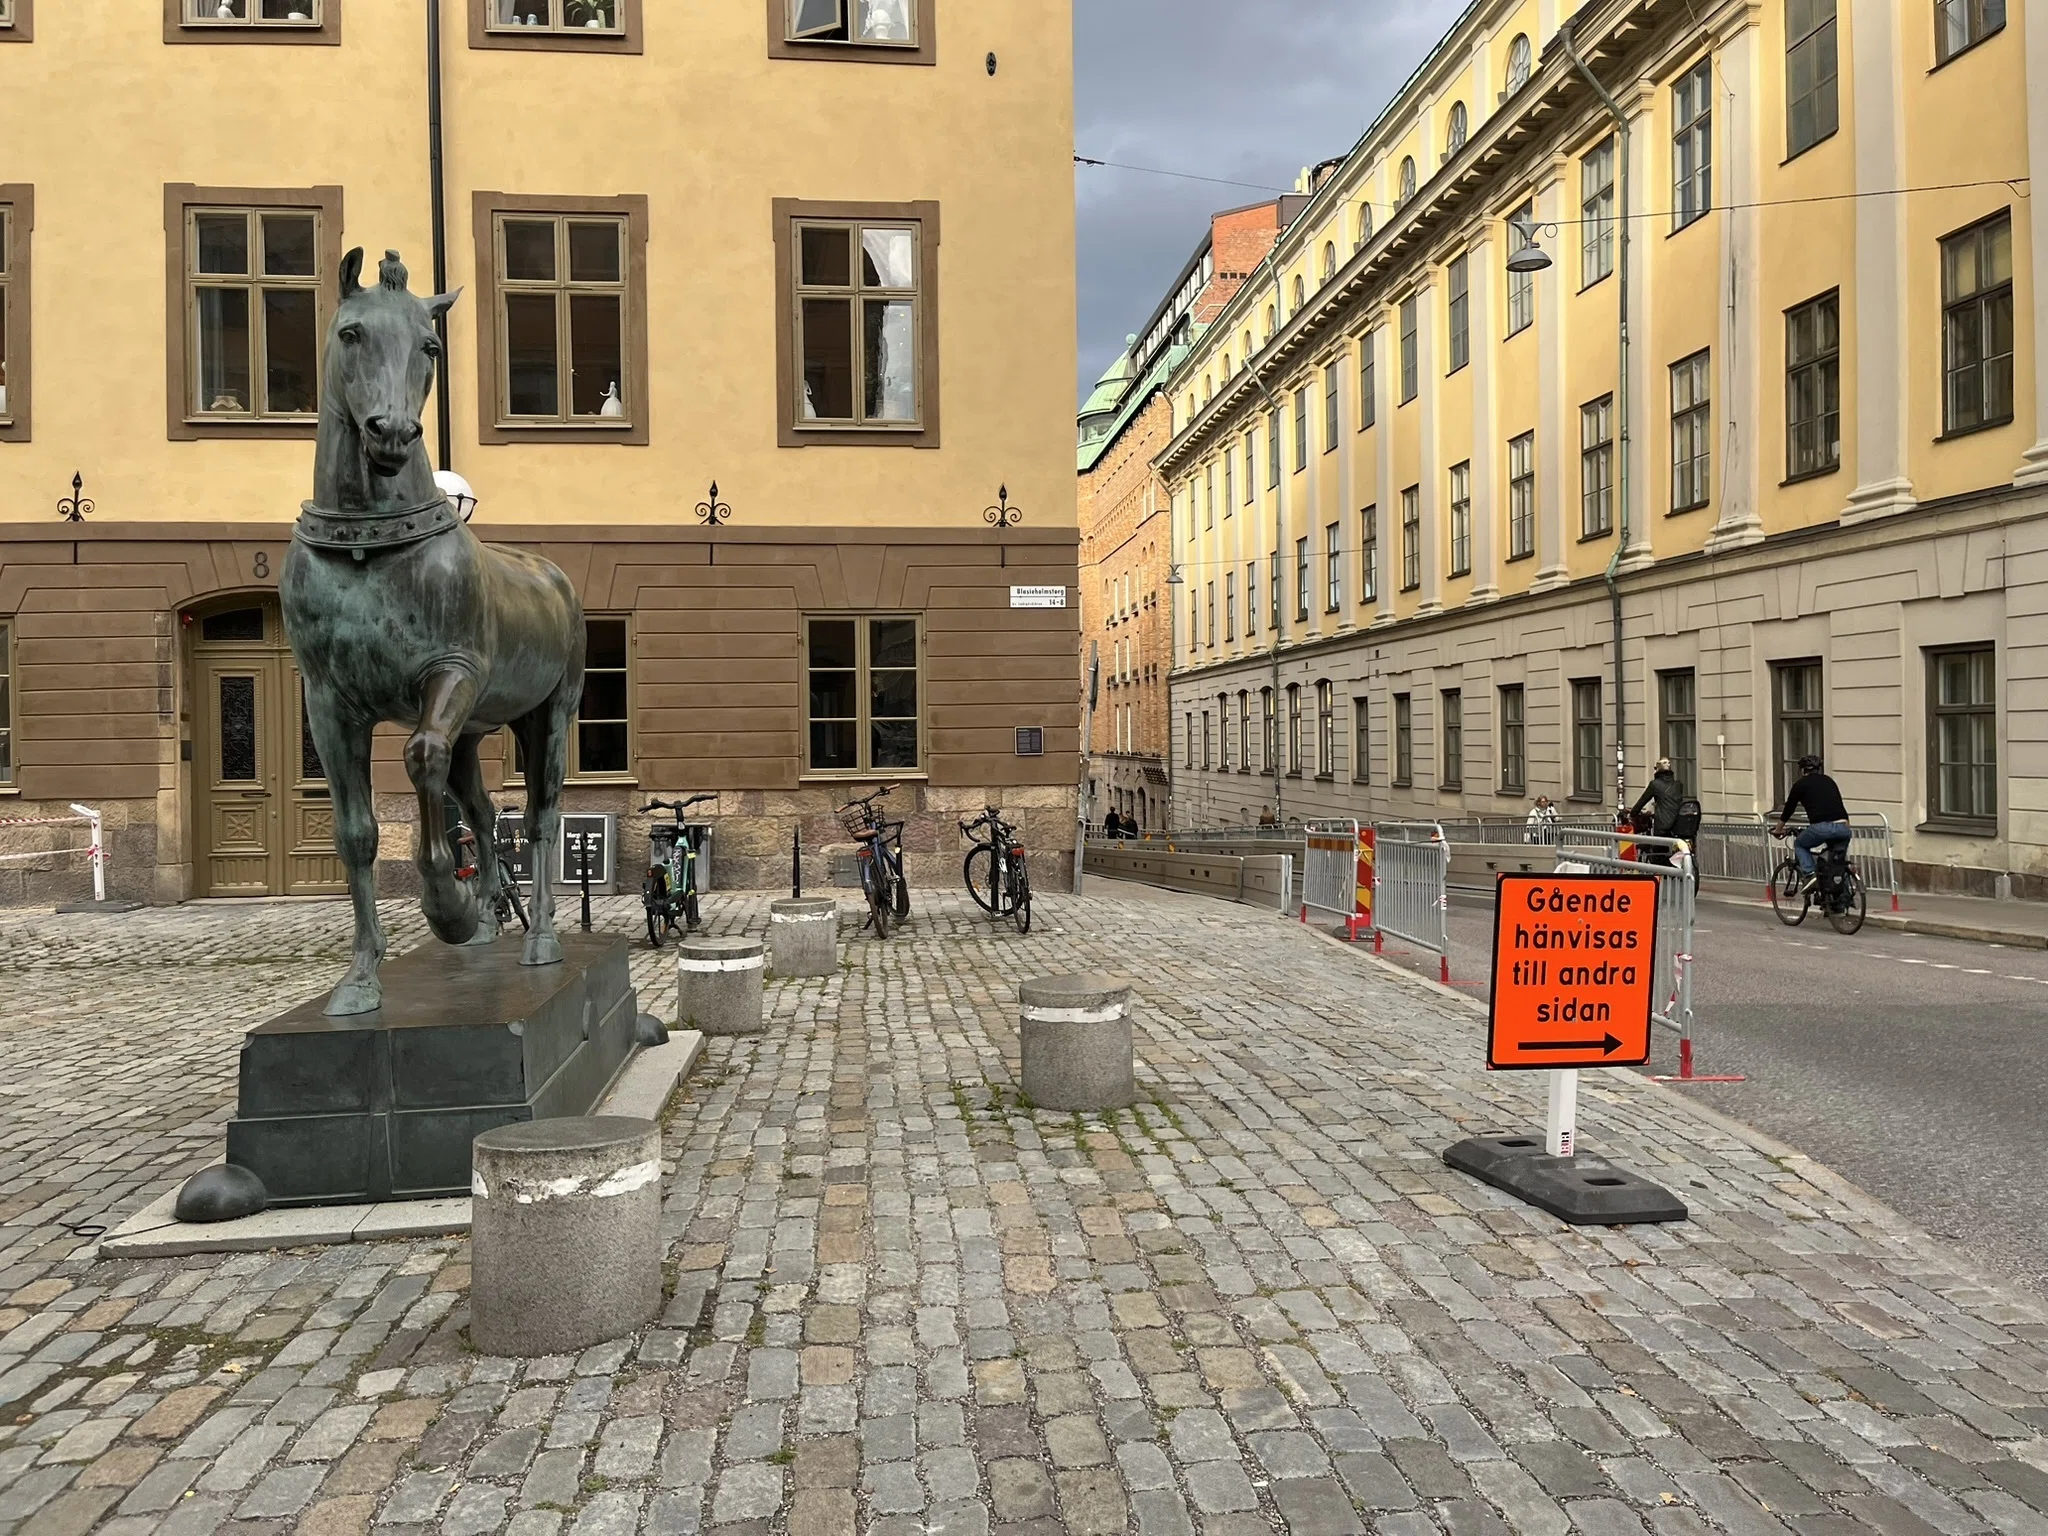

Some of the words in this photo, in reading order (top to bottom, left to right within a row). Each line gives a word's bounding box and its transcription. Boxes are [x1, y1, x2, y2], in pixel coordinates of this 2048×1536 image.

[253, 551, 270, 579] 8
[1527, 886, 1631, 913] Gående
[1515, 923, 1638, 949] hänvisas
[1513, 960, 1547, 985] till
[1559, 960, 1636, 985] andra
[1536, 997, 1610, 1022] sidan
